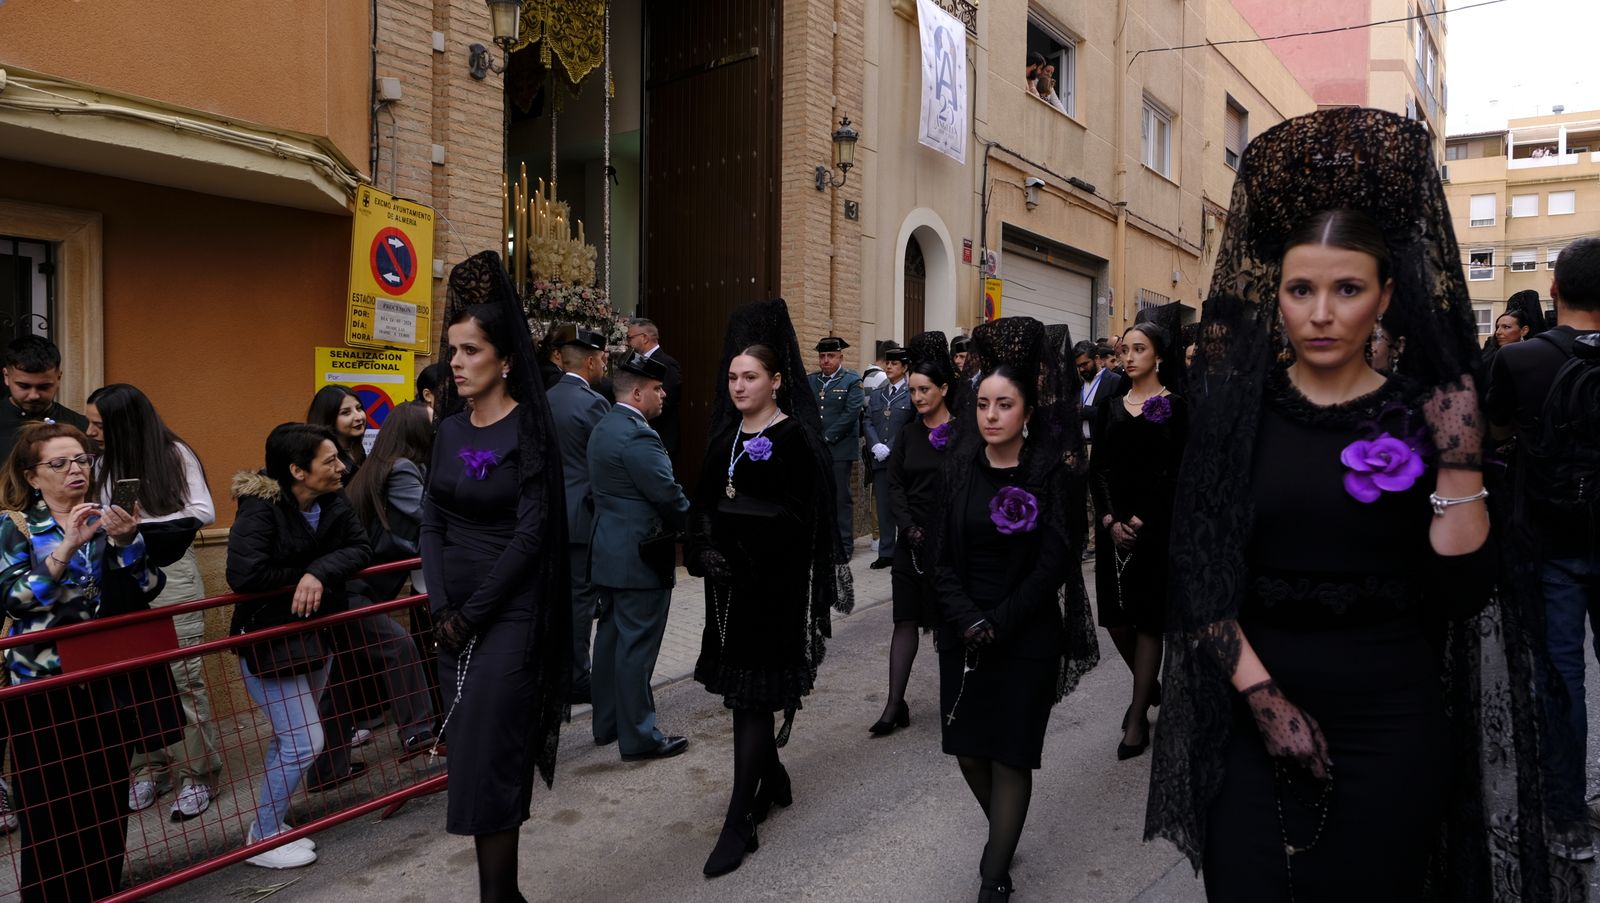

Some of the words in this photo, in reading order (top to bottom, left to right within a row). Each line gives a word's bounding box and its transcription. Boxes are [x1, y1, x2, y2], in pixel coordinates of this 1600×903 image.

[387, 212, 394, 220] DE
[393, 204, 431, 221] AYUNTAMIENTO
[352, 292, 376, 305] ESTACIO
[353, 309, 370, 317] POR:
[352, 320, 367, 328] DÍA:
[352, 332, 374, 341] HORA:
[329, 350, 402, 361] SEÑALIZACIÓN
[332, 361, 400, 371] EXCEPCIONAL
